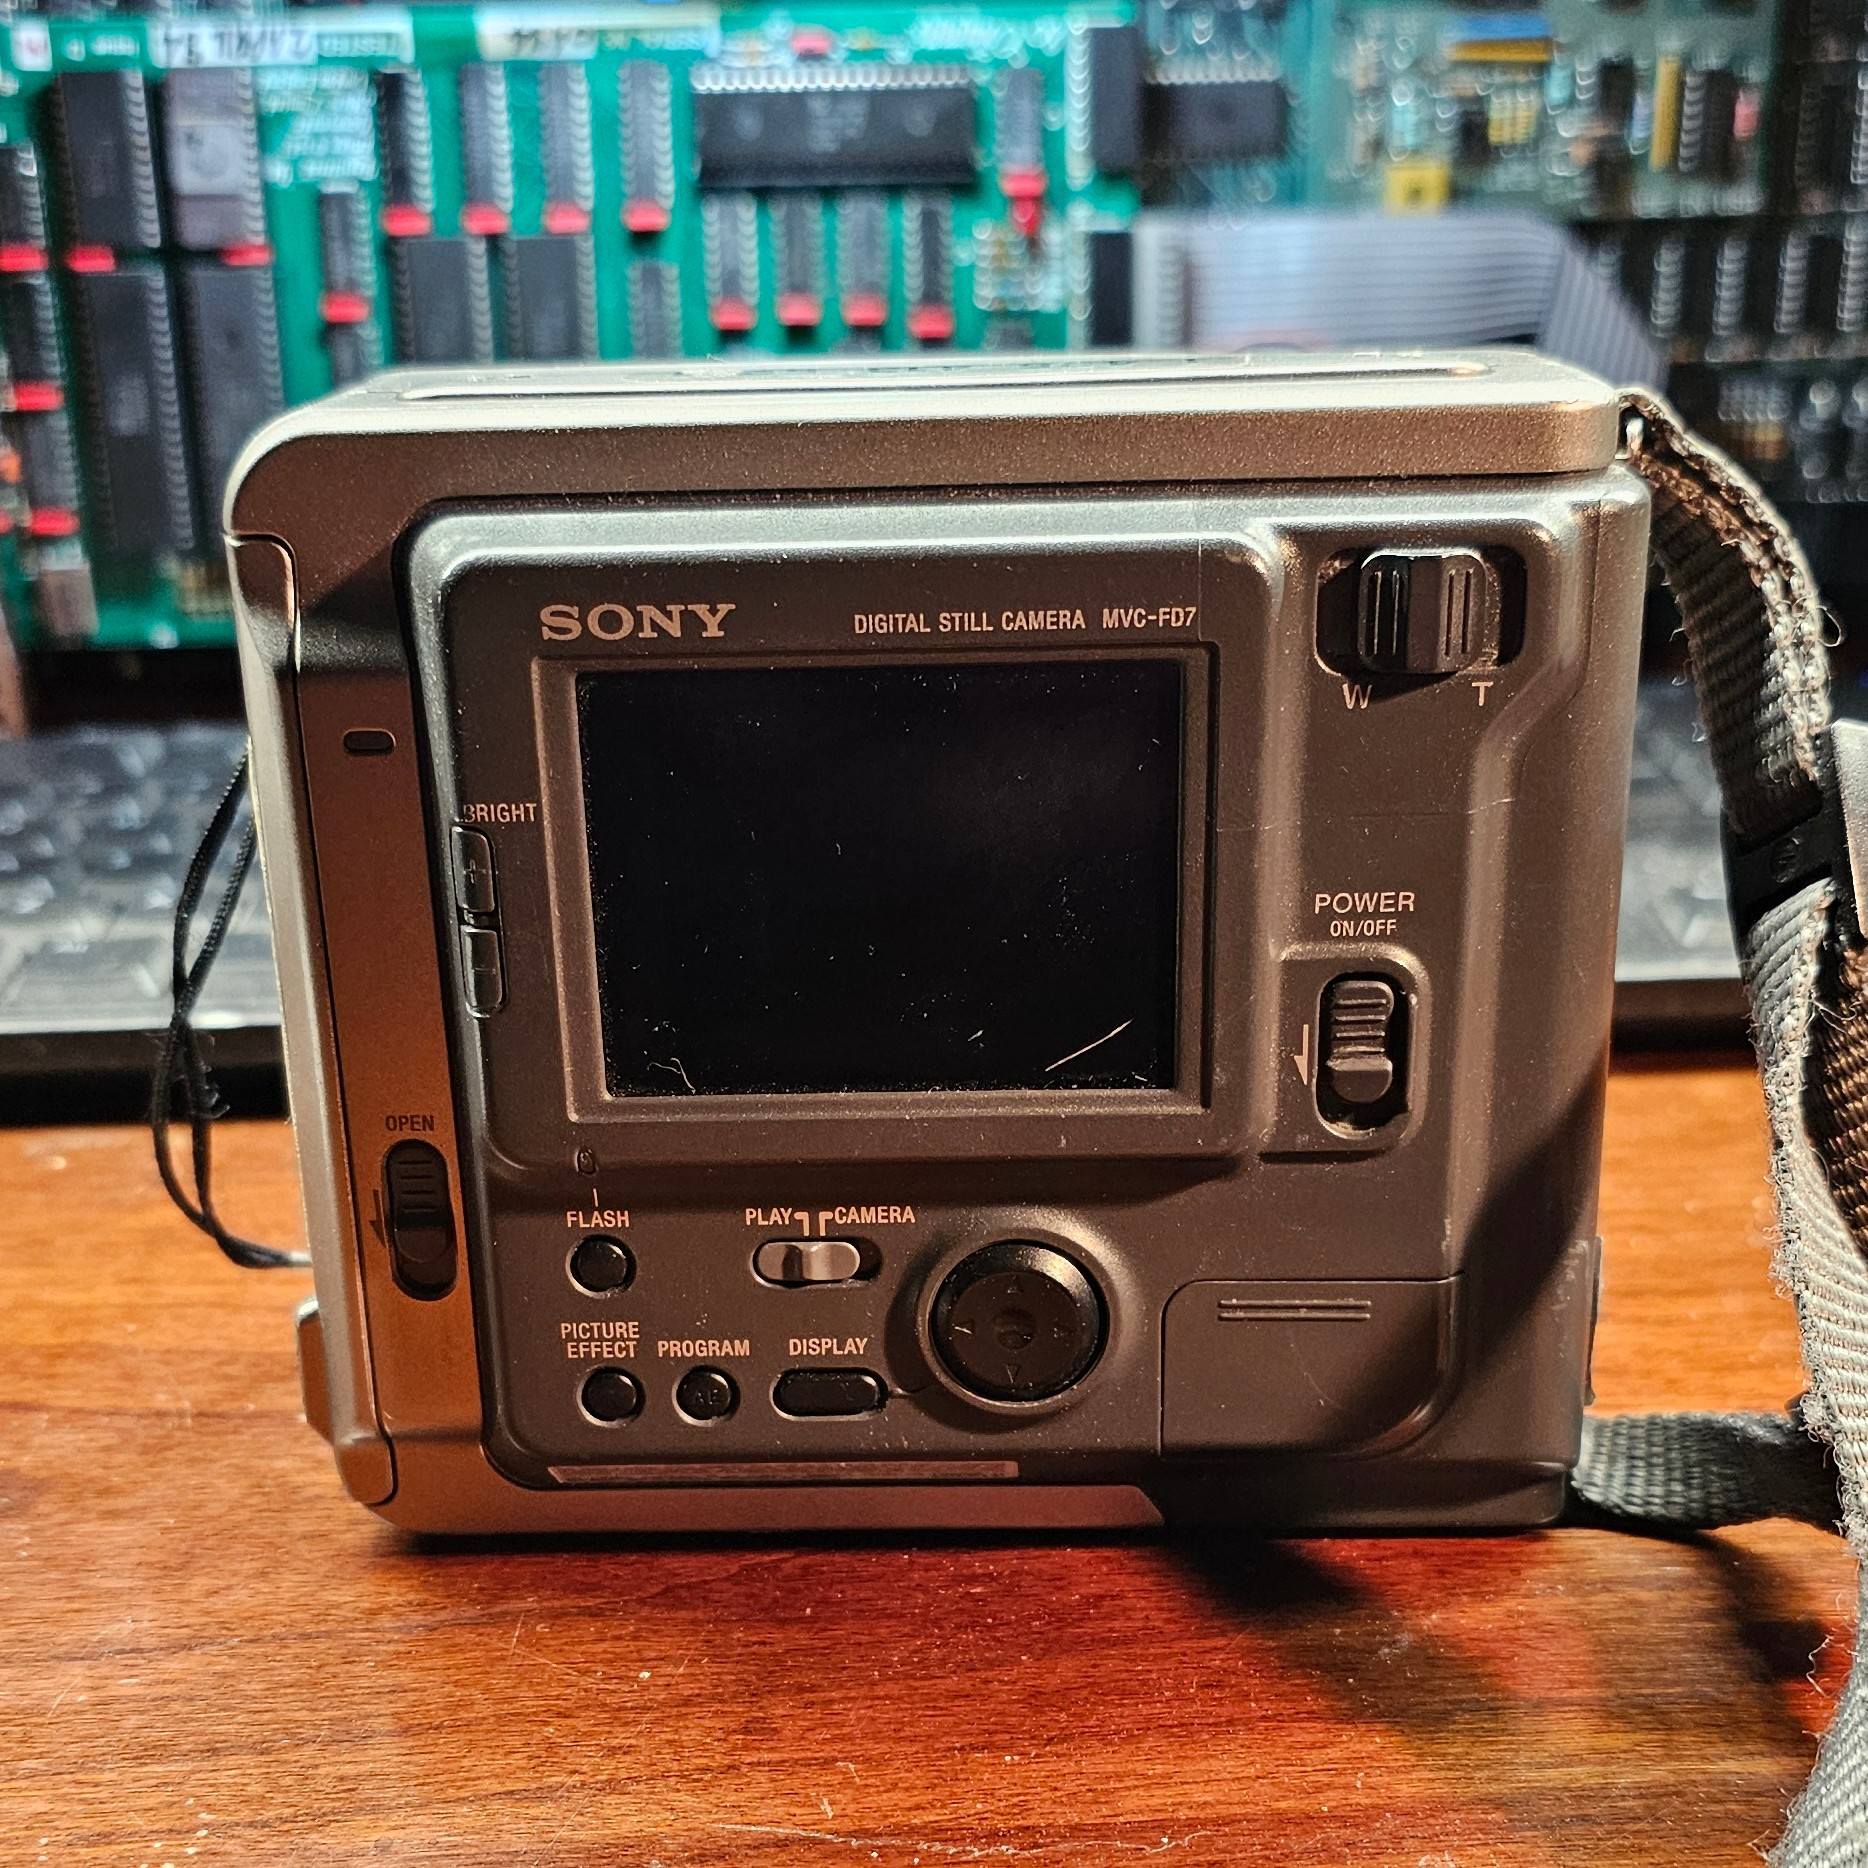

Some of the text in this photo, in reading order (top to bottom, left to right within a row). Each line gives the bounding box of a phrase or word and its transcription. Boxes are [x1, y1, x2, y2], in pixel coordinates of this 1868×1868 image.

[539, 603, 736, 641] SONY
[854, 607, 1197, 634] DIGITAL STILL CAMERA MVC-FD7
[1342, 683, 1373, 710] W
[1471, 681, 1494, 707] T
[1314, 891, 1416, 915] POWER
[1330, 919, 1397, 937] ON/OFF
[385, 1114, 435, 1132] OPEN
[566, 1210, 630, 1228] FLASH
[745, 1207, 793, 1226] PLAY
[834, 1206, 916, 1224] CAMERA
[560, 1321, 640, 1340] PICTURE
[567, 1341, 637, 1359] EFFECT
[657, 1339, 750, 1358] PROGRAM
[789, 1337, 868, 1356] DISPLAY
